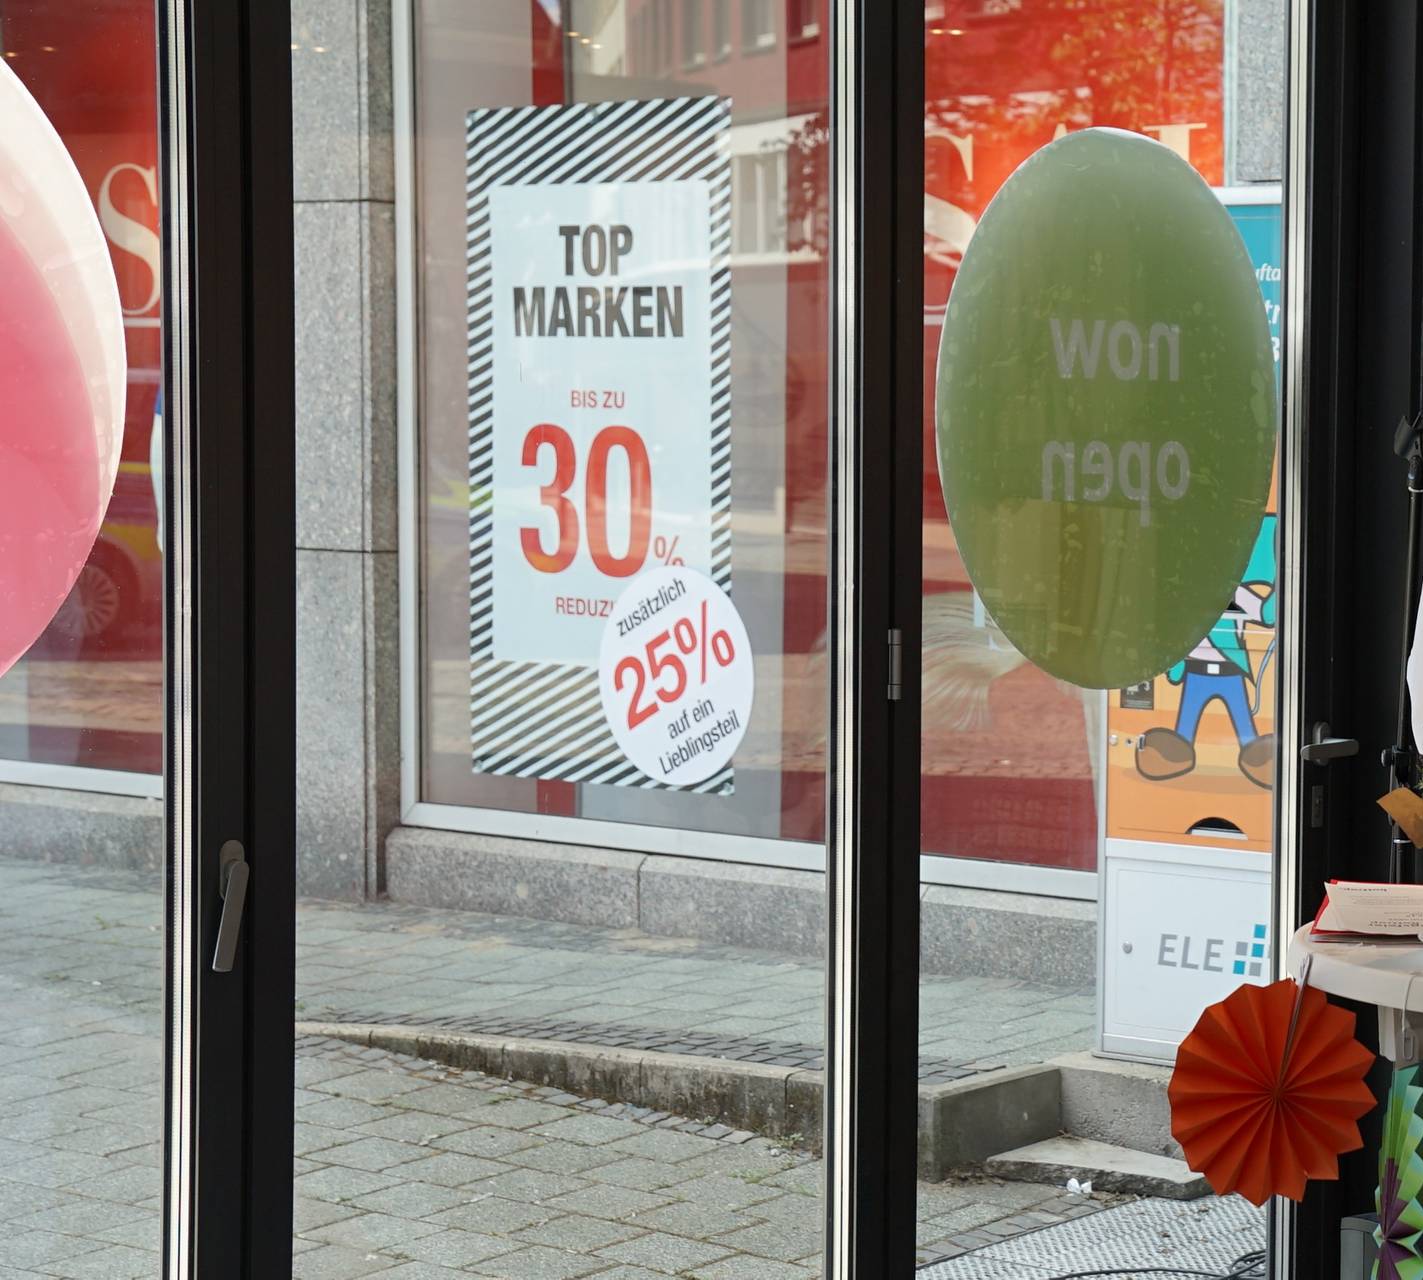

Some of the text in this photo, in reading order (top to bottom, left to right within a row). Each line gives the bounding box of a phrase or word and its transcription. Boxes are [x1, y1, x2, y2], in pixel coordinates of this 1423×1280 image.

[559, 225, 633, 276] TOP
[513, 286, 684, 338] MARKEN
[570, 391, 626, 409] BIS ZU
[616, 578, 687, 637] zusätzlich
[614, 600, 736, 731] 25%
[659, 710, 740, 774] Lieblingsteil
[667, 698, 715, 739] auf ein
[1157, 933, 1224, 973] ELE
